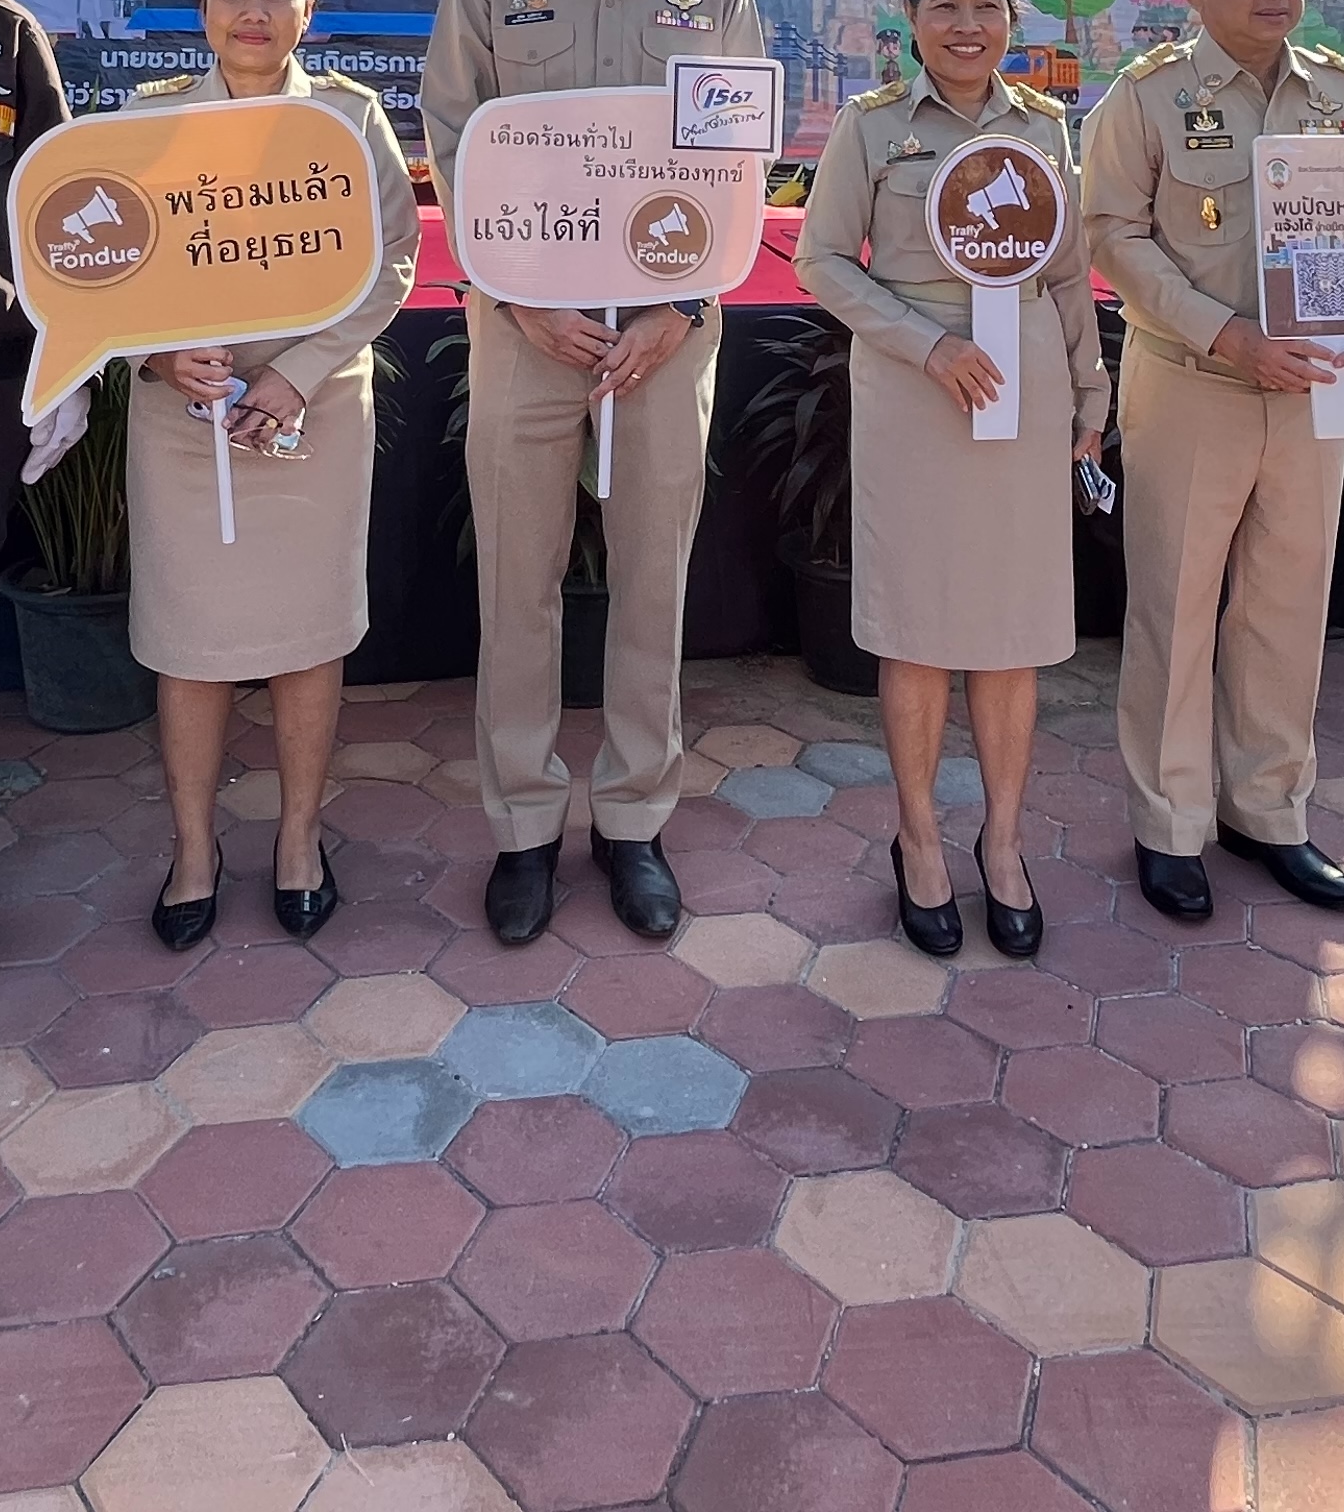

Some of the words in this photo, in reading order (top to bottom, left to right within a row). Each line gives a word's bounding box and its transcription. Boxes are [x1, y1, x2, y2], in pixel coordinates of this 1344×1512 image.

[703, 88, 753, 108] 1567
[490, 123, 633, 150] เดือดร้อนทั่วไป
[583, 155, 746, 188] ร้องเรียนร้องทุกข์
[164, 161, 353, 217] พร้อมแล้ว
[473, 198, 601, 242] แจ้งได้ที่
[949, 223, 984, 238] Traffy
[1274, 218, 1313, 231] แจ้งได้
[47, 239, 81, 252] Traffy
[49, 245, 141, 269] Fondue
[185, 219, 344, 270] ที่อยุธยา
[637, 248, 699, 264] Fondue
[950, 234, 1046, 260] Fondue
